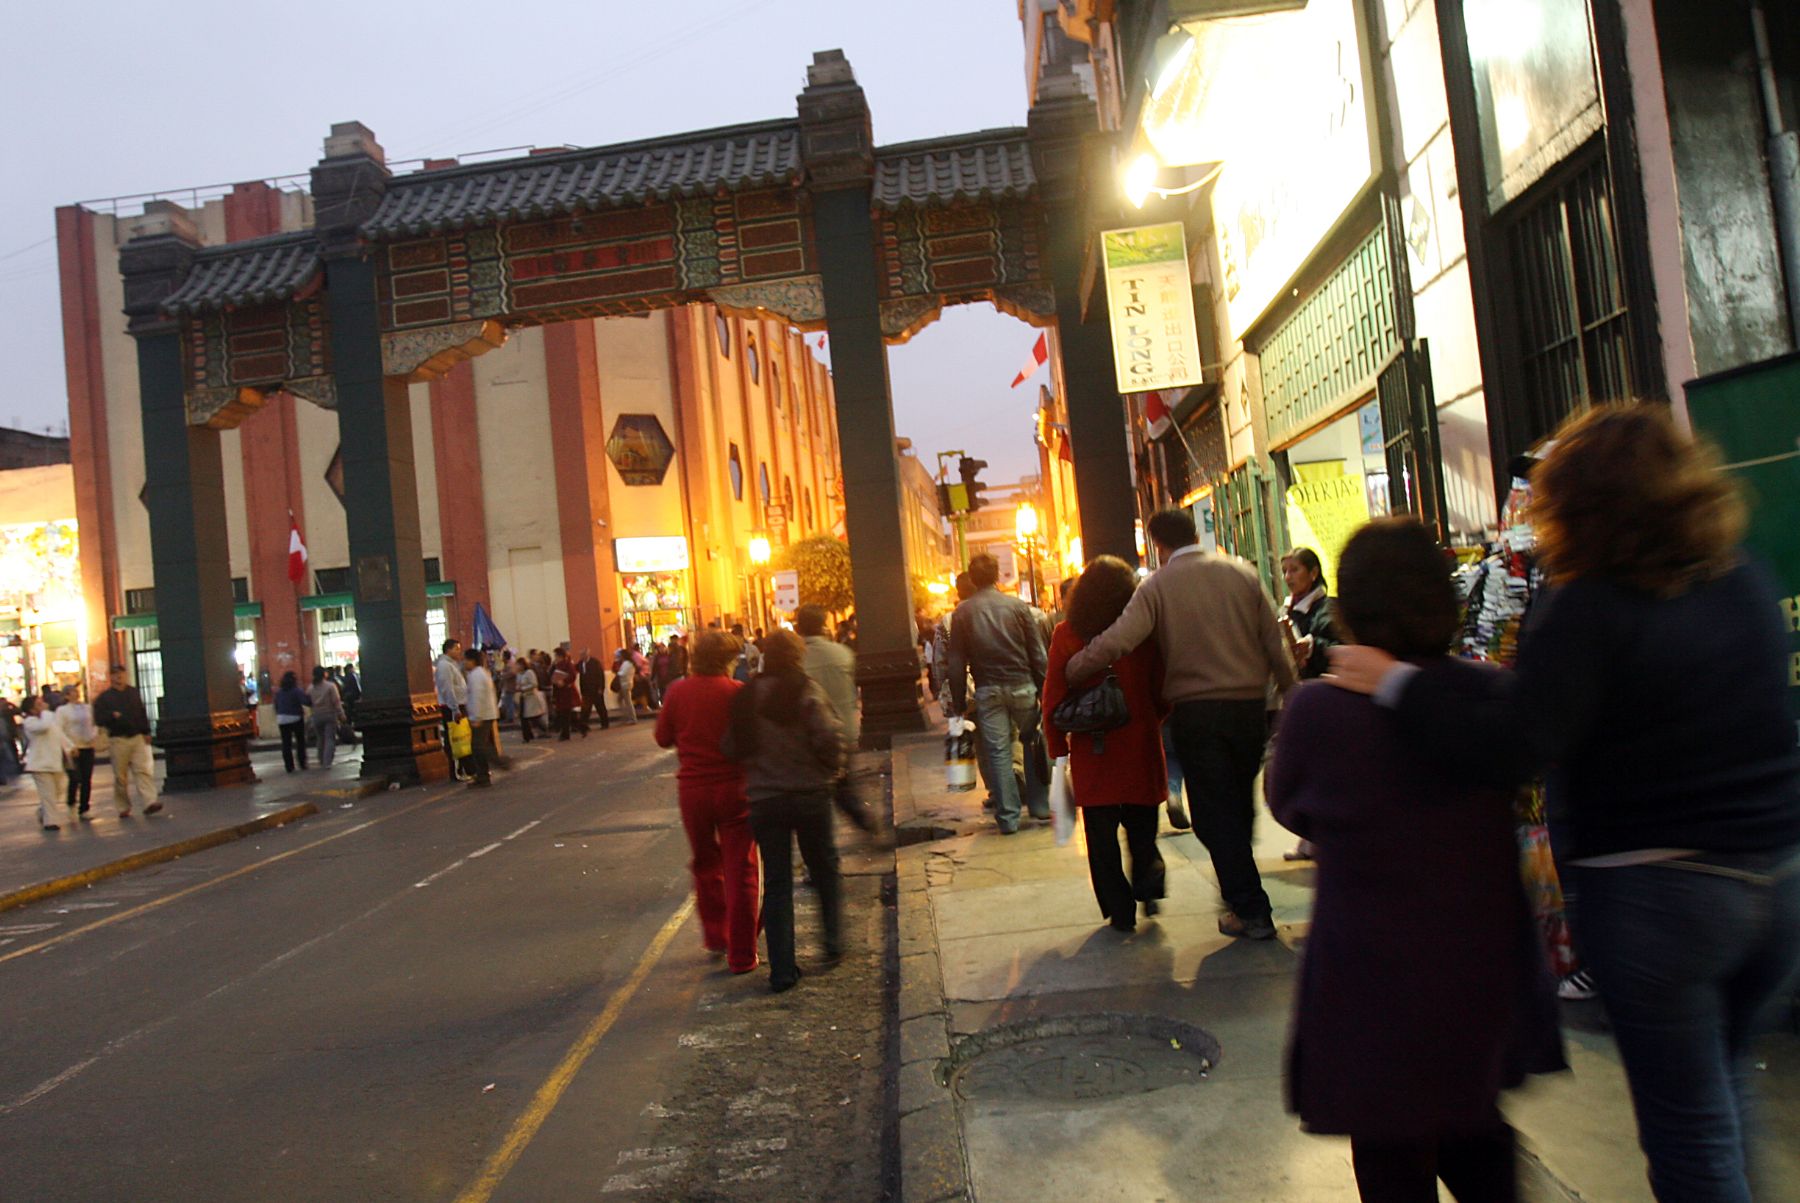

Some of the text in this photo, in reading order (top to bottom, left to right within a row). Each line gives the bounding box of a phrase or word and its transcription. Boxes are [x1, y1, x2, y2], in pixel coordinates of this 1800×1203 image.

[1121, 278, 1154, 375] TIN LONG
[1291, 479, 1360, 504] OFERTAS
